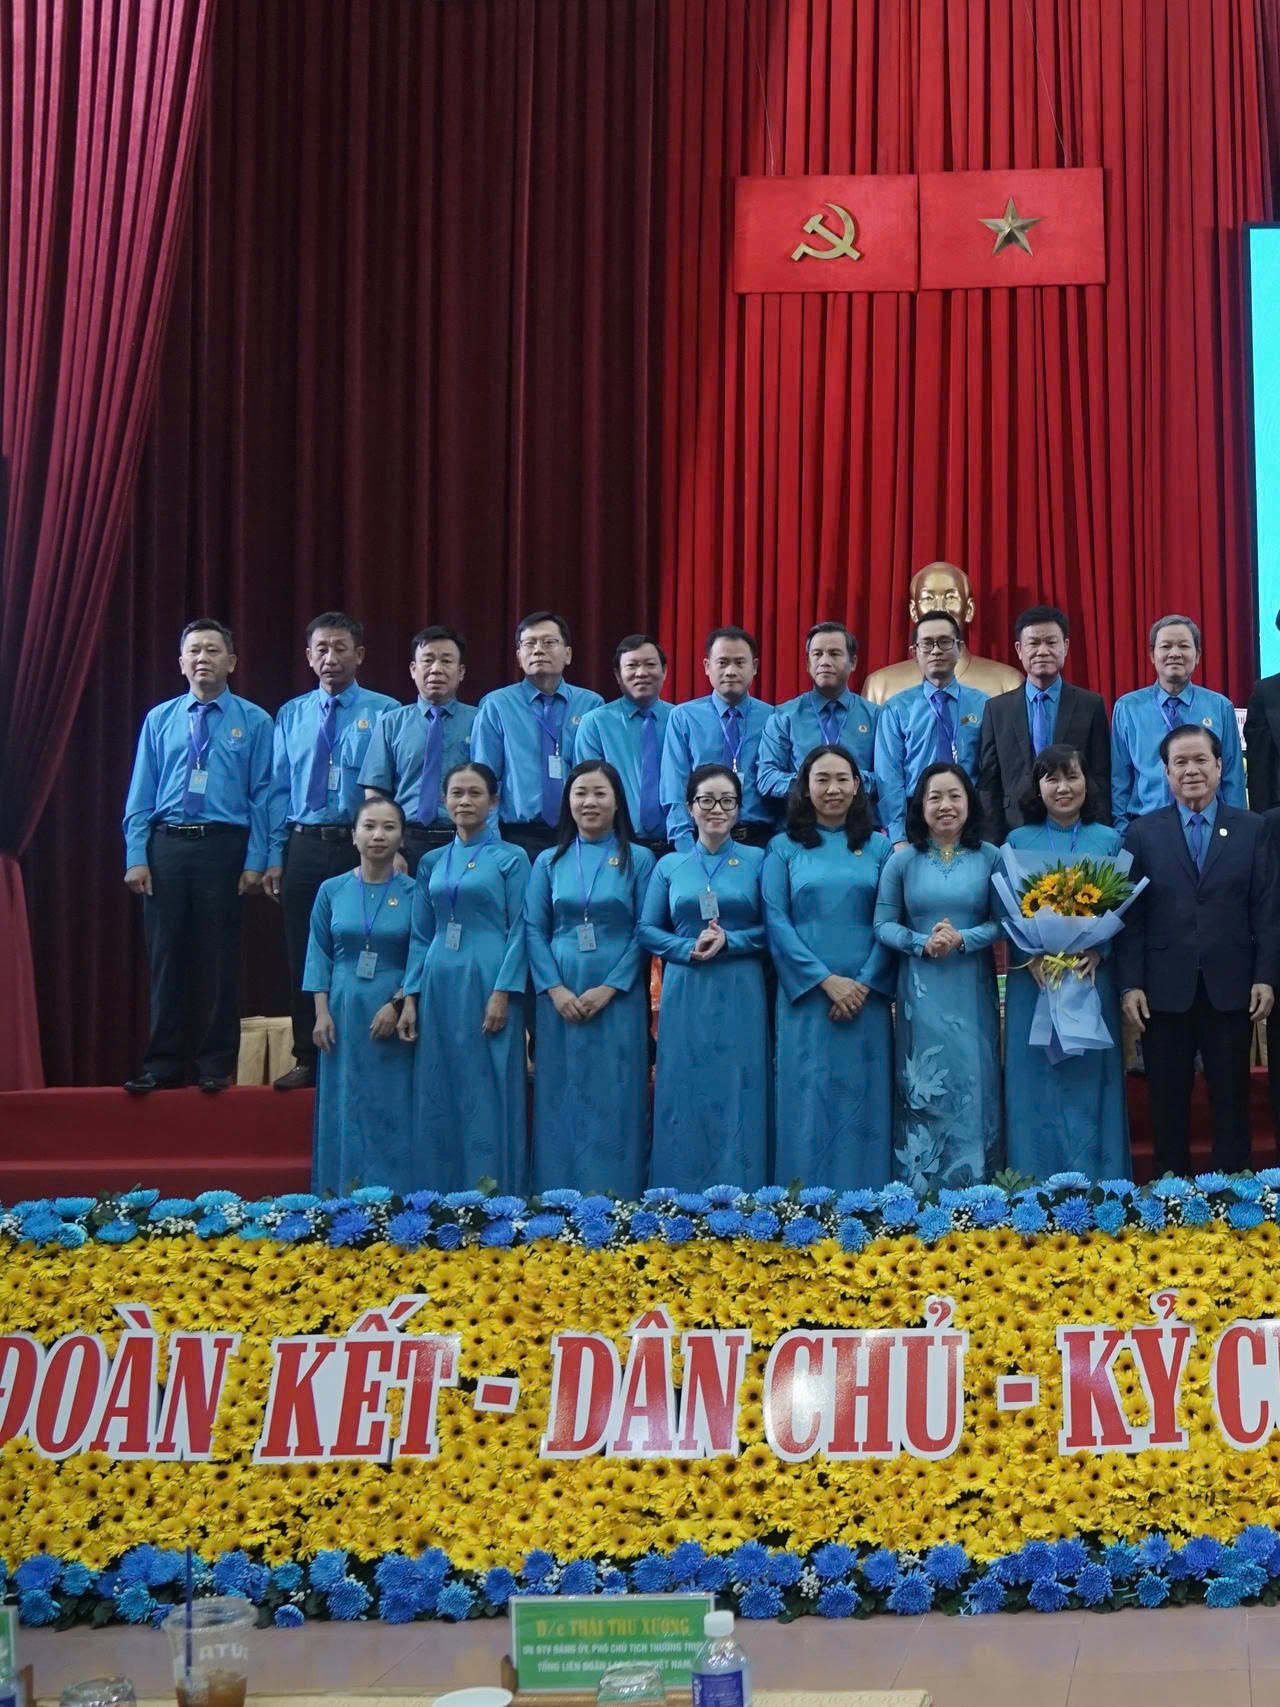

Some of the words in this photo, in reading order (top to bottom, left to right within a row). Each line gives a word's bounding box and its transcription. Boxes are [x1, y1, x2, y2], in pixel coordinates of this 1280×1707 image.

[260, 1301, 455, 1457] KẾT
[547, 1310, 745, 1452] DÂN
[771, 1301, 963, 1454] CHỦ
[1063, 1293, 1190, 1447] KỶ
